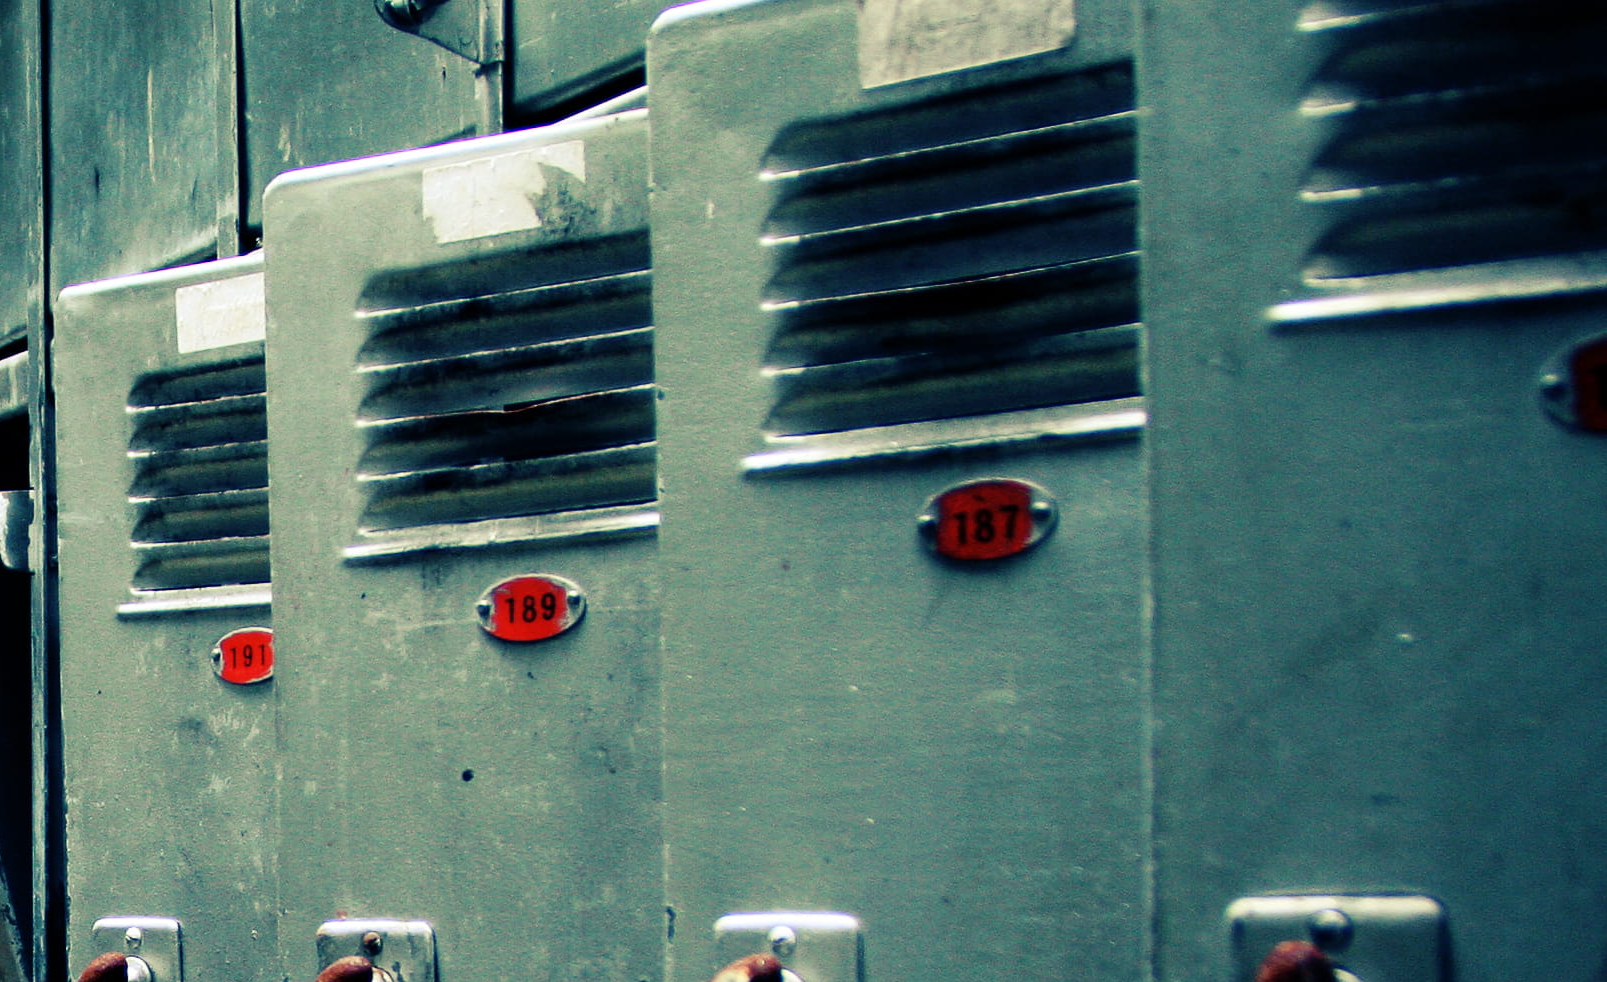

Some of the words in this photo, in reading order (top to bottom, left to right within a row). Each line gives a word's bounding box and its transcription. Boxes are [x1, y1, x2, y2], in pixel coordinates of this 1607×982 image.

[954, 504, 1019, 544] 187
[505, 592, 556, 623] 189
[230, 644, 265, 669] 191
